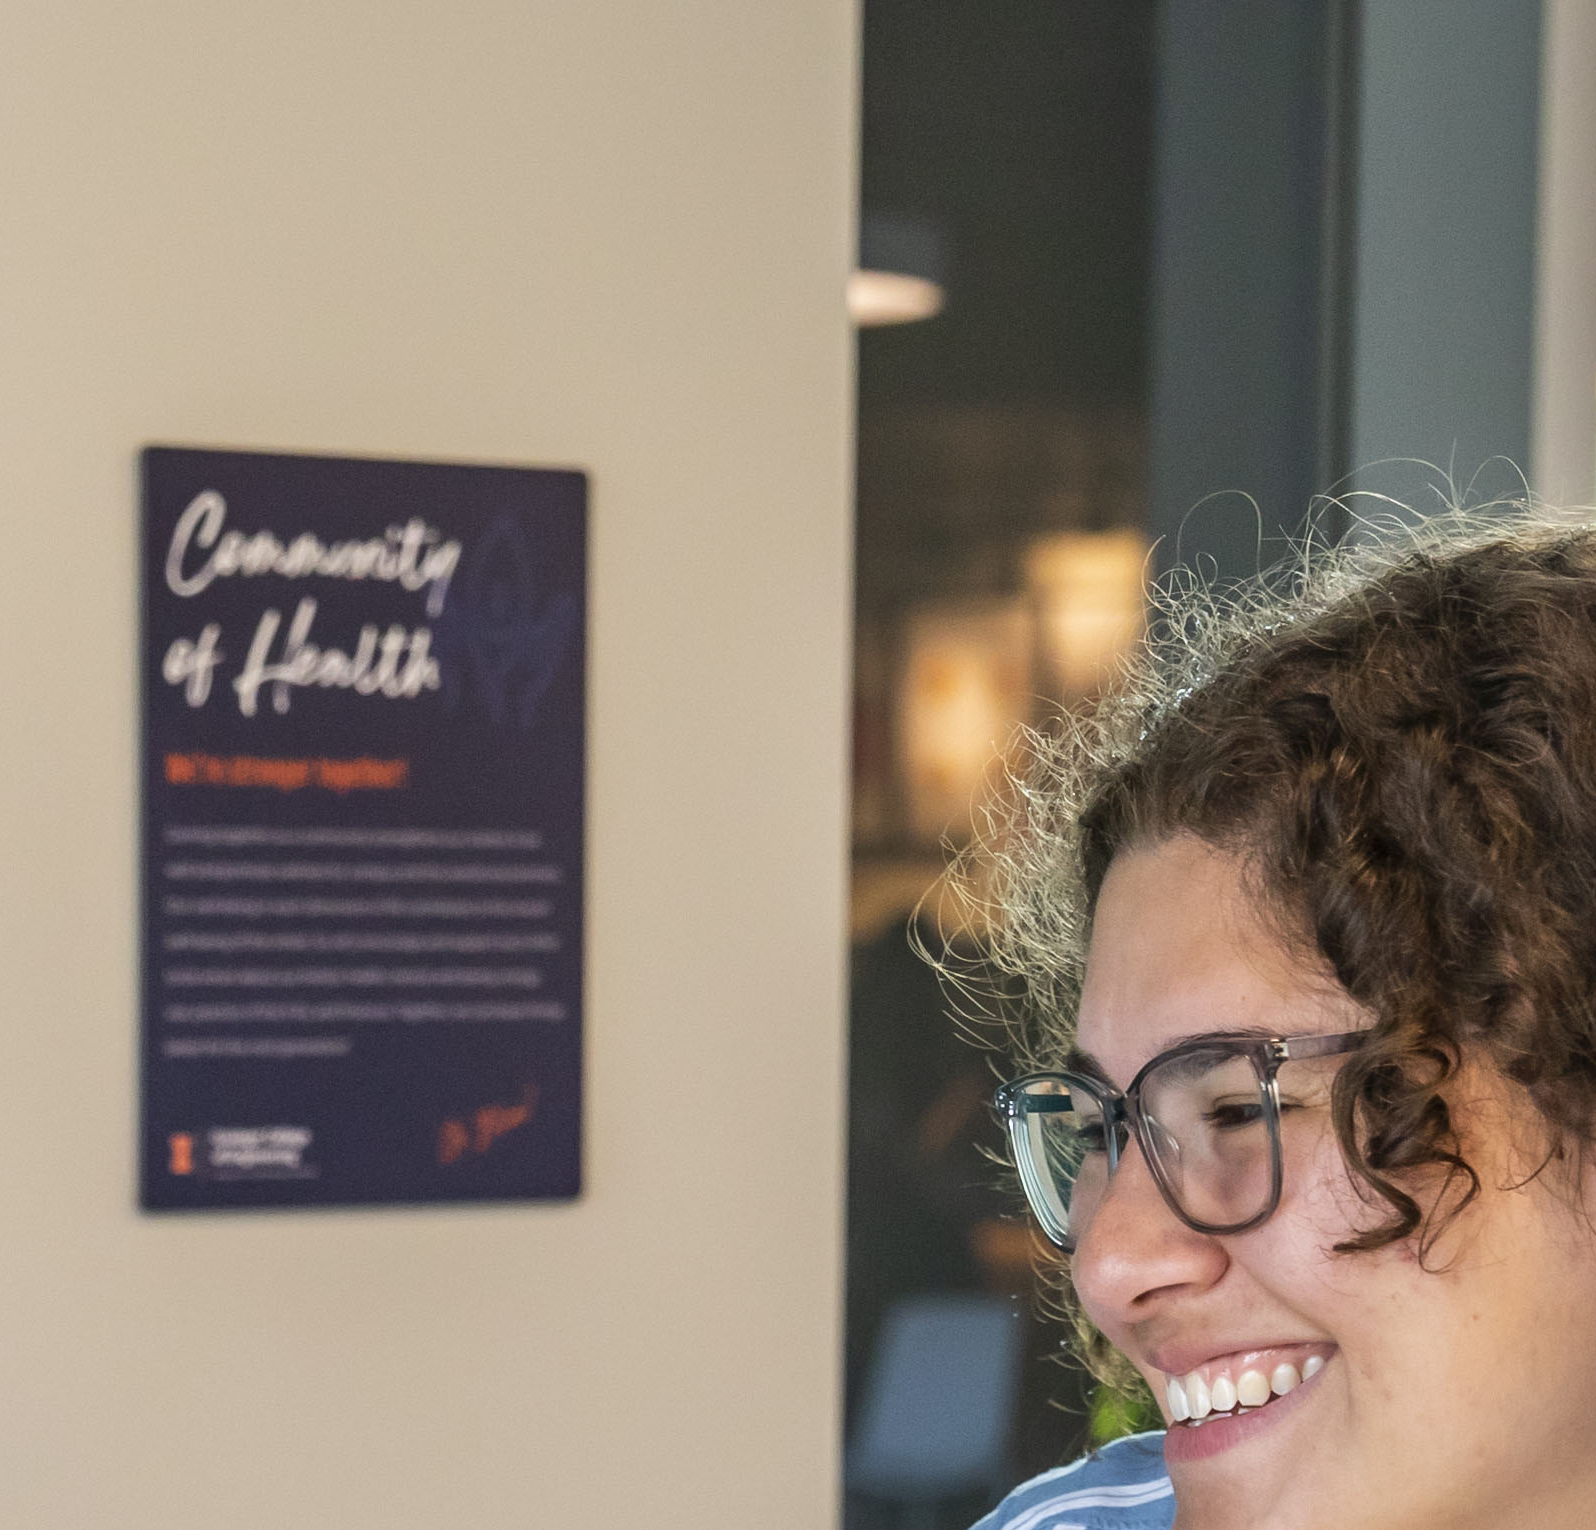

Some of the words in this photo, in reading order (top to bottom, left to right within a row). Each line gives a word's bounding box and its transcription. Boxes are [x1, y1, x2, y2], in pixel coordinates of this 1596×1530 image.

[165, 489, 463, 618] Community
[163, 622, 223, 708] of
[232, 596, 441, 717] Health
